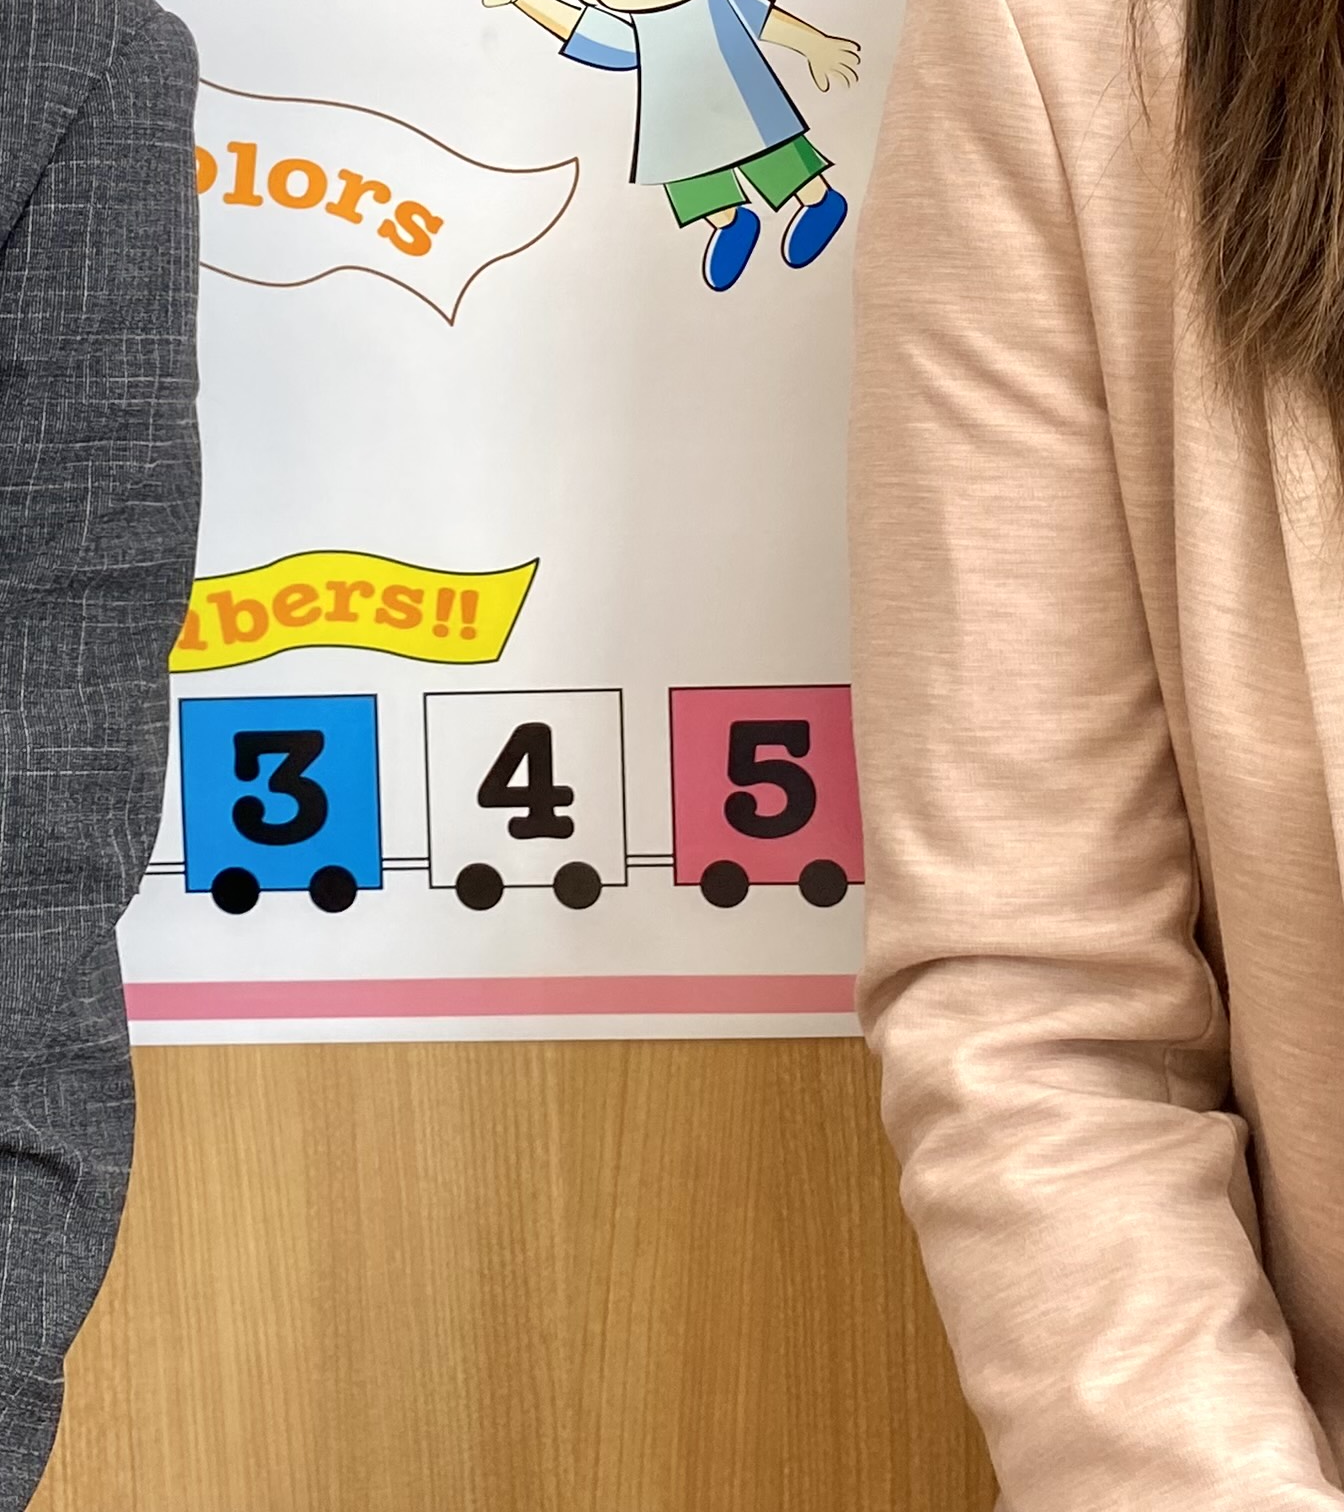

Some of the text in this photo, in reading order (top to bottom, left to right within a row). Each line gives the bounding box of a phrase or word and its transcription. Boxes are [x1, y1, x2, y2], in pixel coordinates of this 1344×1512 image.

[231, 719, 817, 846] 3 4 5
